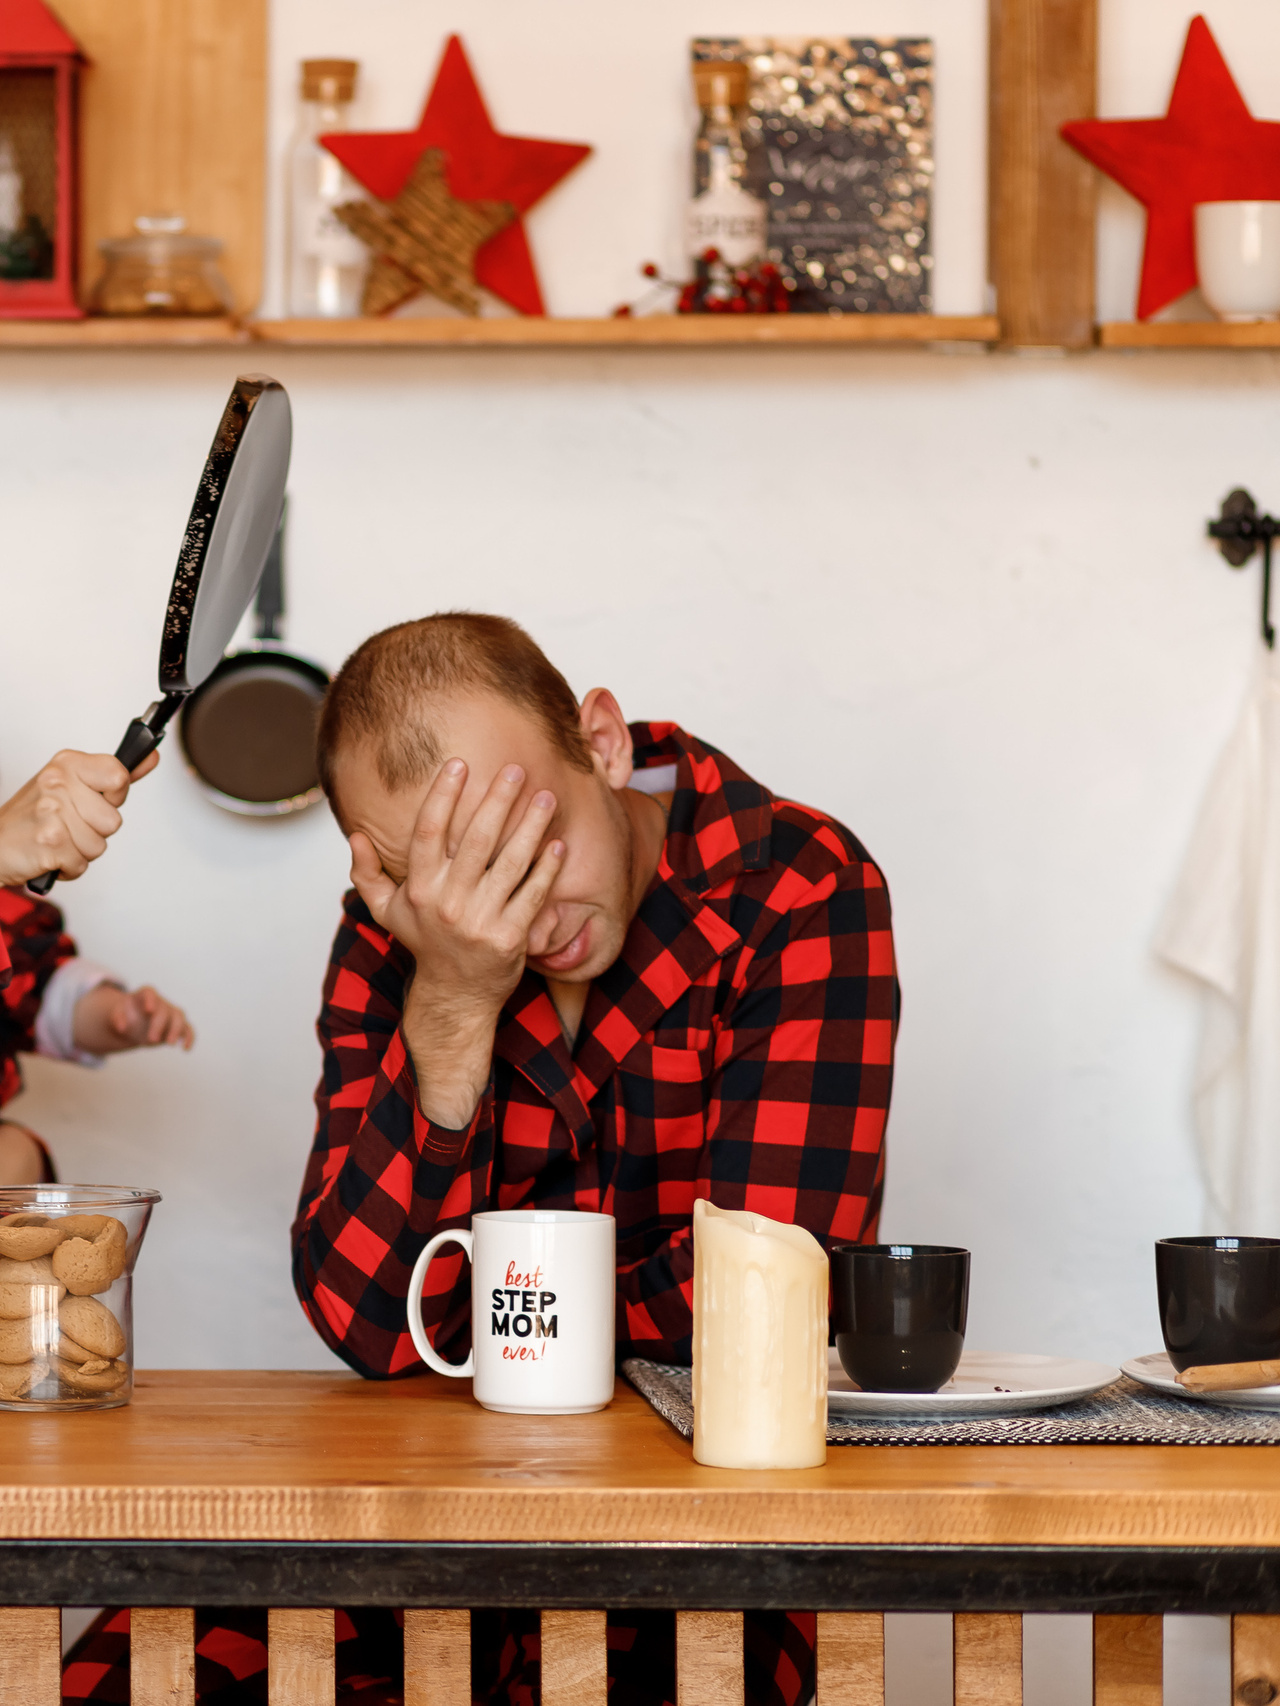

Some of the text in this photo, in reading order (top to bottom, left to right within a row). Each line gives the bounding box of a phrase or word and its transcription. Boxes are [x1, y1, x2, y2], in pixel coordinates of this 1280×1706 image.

[505, 1260, 544, 1288] best
[491, 1288, 557, 1313] STEP
[491, 1312, 558, 1339] MOM
[502, 1341, 547, 1361] ever!
